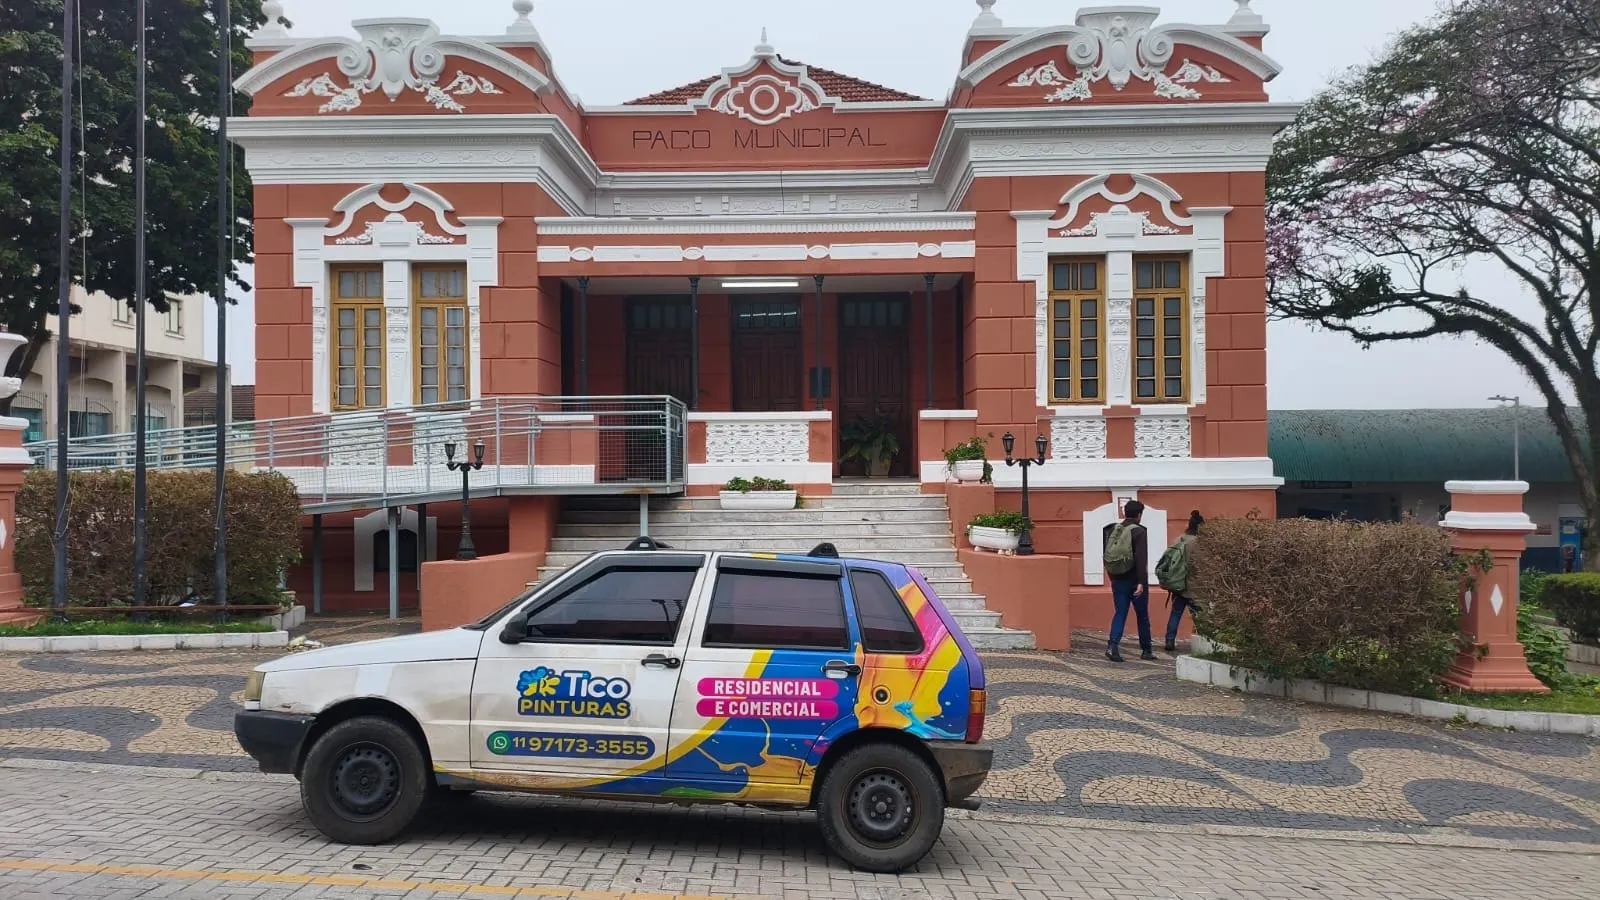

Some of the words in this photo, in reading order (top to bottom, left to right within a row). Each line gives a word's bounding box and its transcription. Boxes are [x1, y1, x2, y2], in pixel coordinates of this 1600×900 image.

[734, 127, 887, 148] MUNICIPAL
[714, 679, 821, 696] RESIDENCIAL
[520, 699, 628, 717] PINTURAS
[715, 702, 724, 715] E
[728, 702, 820, 717] COMERCIAL
[512, 736, 526, 748] 11
[529, 736, 649, 756] 97173-3555
